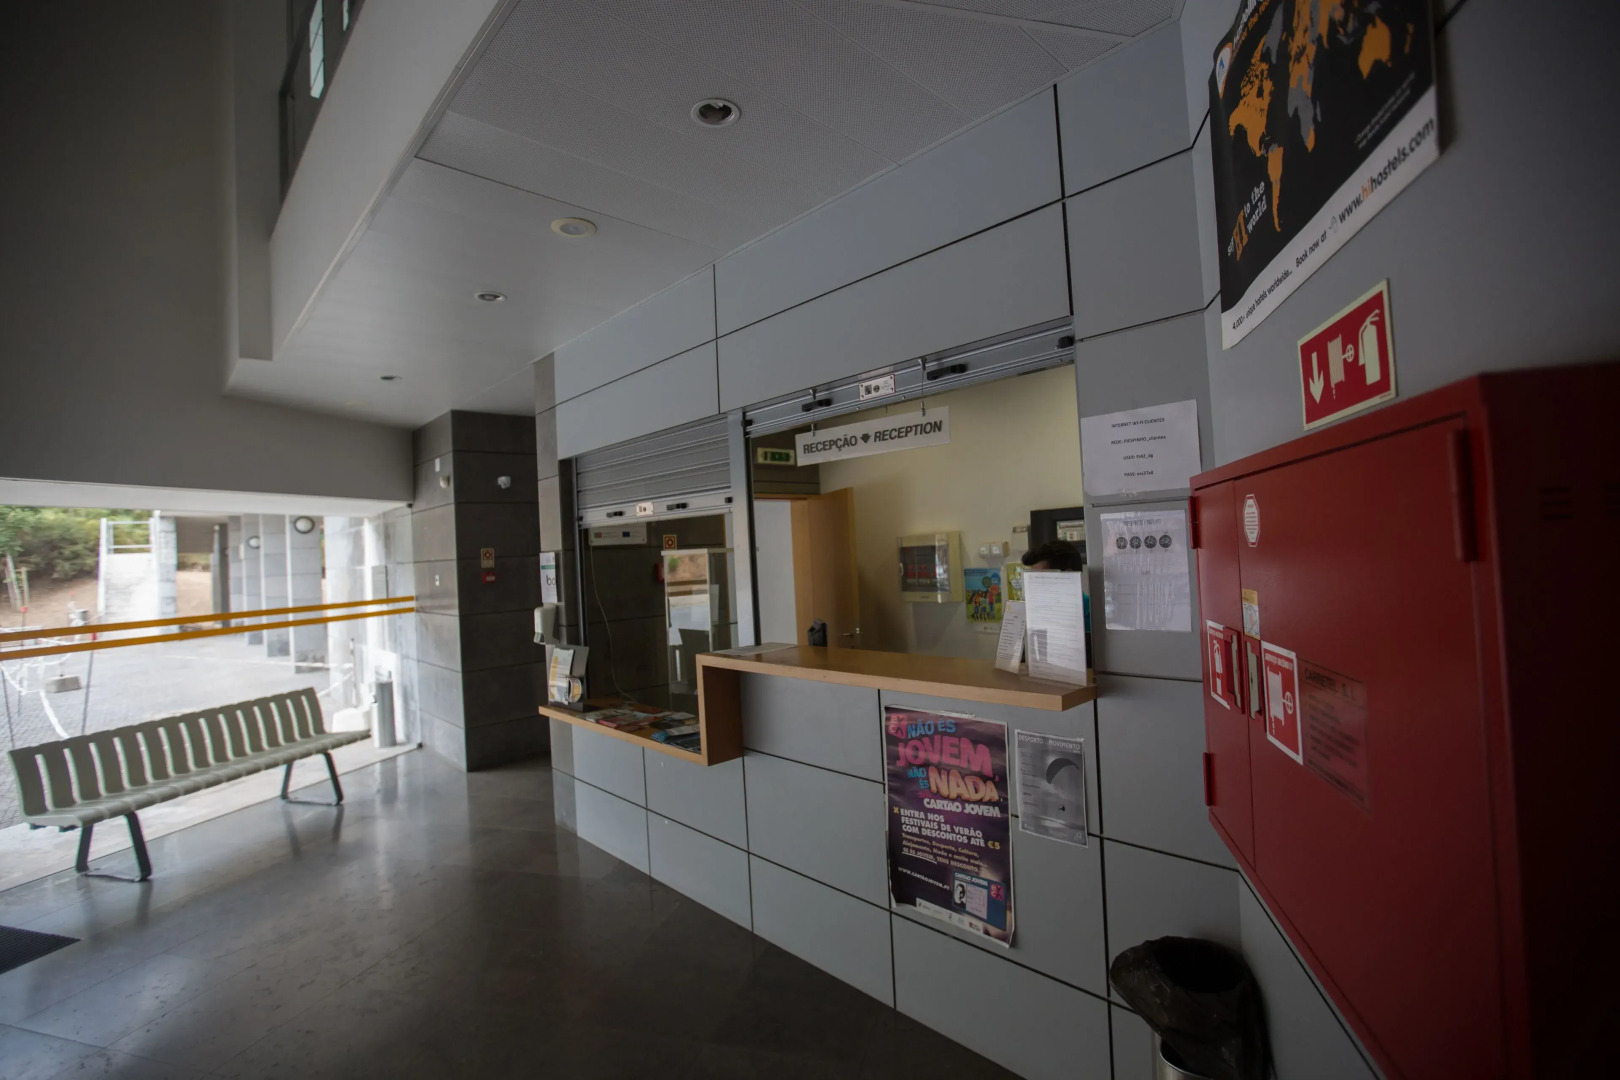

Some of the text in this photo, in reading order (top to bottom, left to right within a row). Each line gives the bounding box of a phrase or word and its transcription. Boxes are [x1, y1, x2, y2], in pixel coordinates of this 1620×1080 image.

[1339, 117, 1435, 224] www.hihostels.com
[1233, 209, 1248, 261] HI
[1243, 203, 1250, 217] to
[1251, 182, 1265, 205] the
[1247, 194, 1267, 233] world
[1296, 229, 1327, 268] Book now at
[1255, 290, 1267, 307] hostels
[803, 420, 942, 454] RECEPÇÃO RECEPTION
[907, 717, 957, 739] NÃO ÉS
[1048, 739, 1081, 751] MOVIMENTO
[908, 766, 927, 778] NÃO
[919, 777, 929, 789] ÉS
[900, 808, 944, 823] ENTRA NOS
[923, 798, 1001, 818] CARTÃO JOVEM
[901, 817, 983, 838] FESTIVAIS DE VERÃO
[902, 825, 920, 835] COM
[922, 829, 968, 844] DESCONTOS
[970, 836, 986, 848] ATÉ
